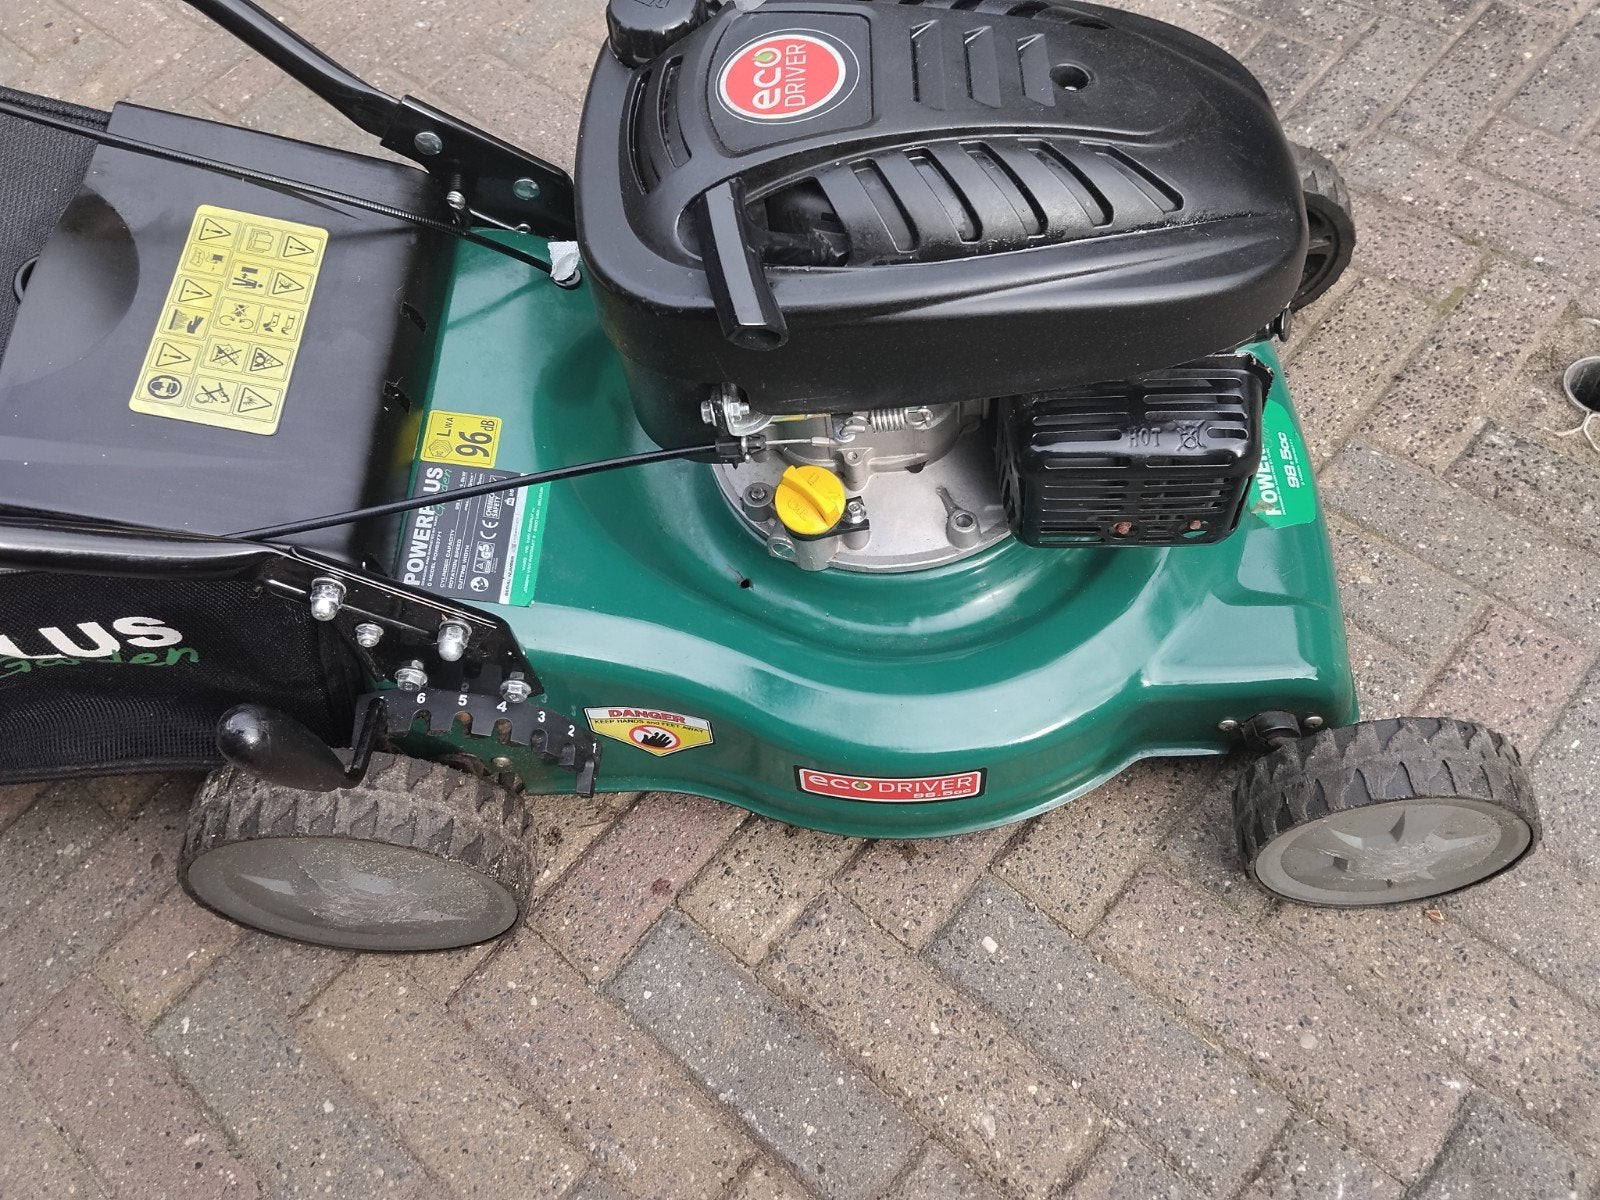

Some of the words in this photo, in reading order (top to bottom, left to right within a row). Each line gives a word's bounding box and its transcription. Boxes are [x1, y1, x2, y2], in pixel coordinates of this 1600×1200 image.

[752, 47, 782, 110] eco
[784, 43, 807, 107] DRIVER
[455, 431, 493, 458] 96
[480, 420, 495, 431] dB
[1128, 427, 1161, 448] HOT
[1278, 432, 1300, 488] 98.5cc
[404, 467, 443, 585] POWERPUS
[492, 496, 501, 519] SAFETY
[446, 529, 455, 558] CAPACITY
[448, 555, 458, 588] ROTATION
[454, 539, 462, 558] SPEED
[458, 563, 466, 590] CUTTING
[462, 545, 470, 563] WIDTH
[417, 692, 426, 704] 6
[458, 694, 468, 706] 5
[497, 701, 507, 713] 4
[537, 711, 546, 722] 3
[568, 725, 575, 737] 2
[592, 742, 598, 754] 1
[608, 709, 686, 723] DANGER
[808, 775, 872, 791] eco
[878, 776, 973, 793] DRIVER
